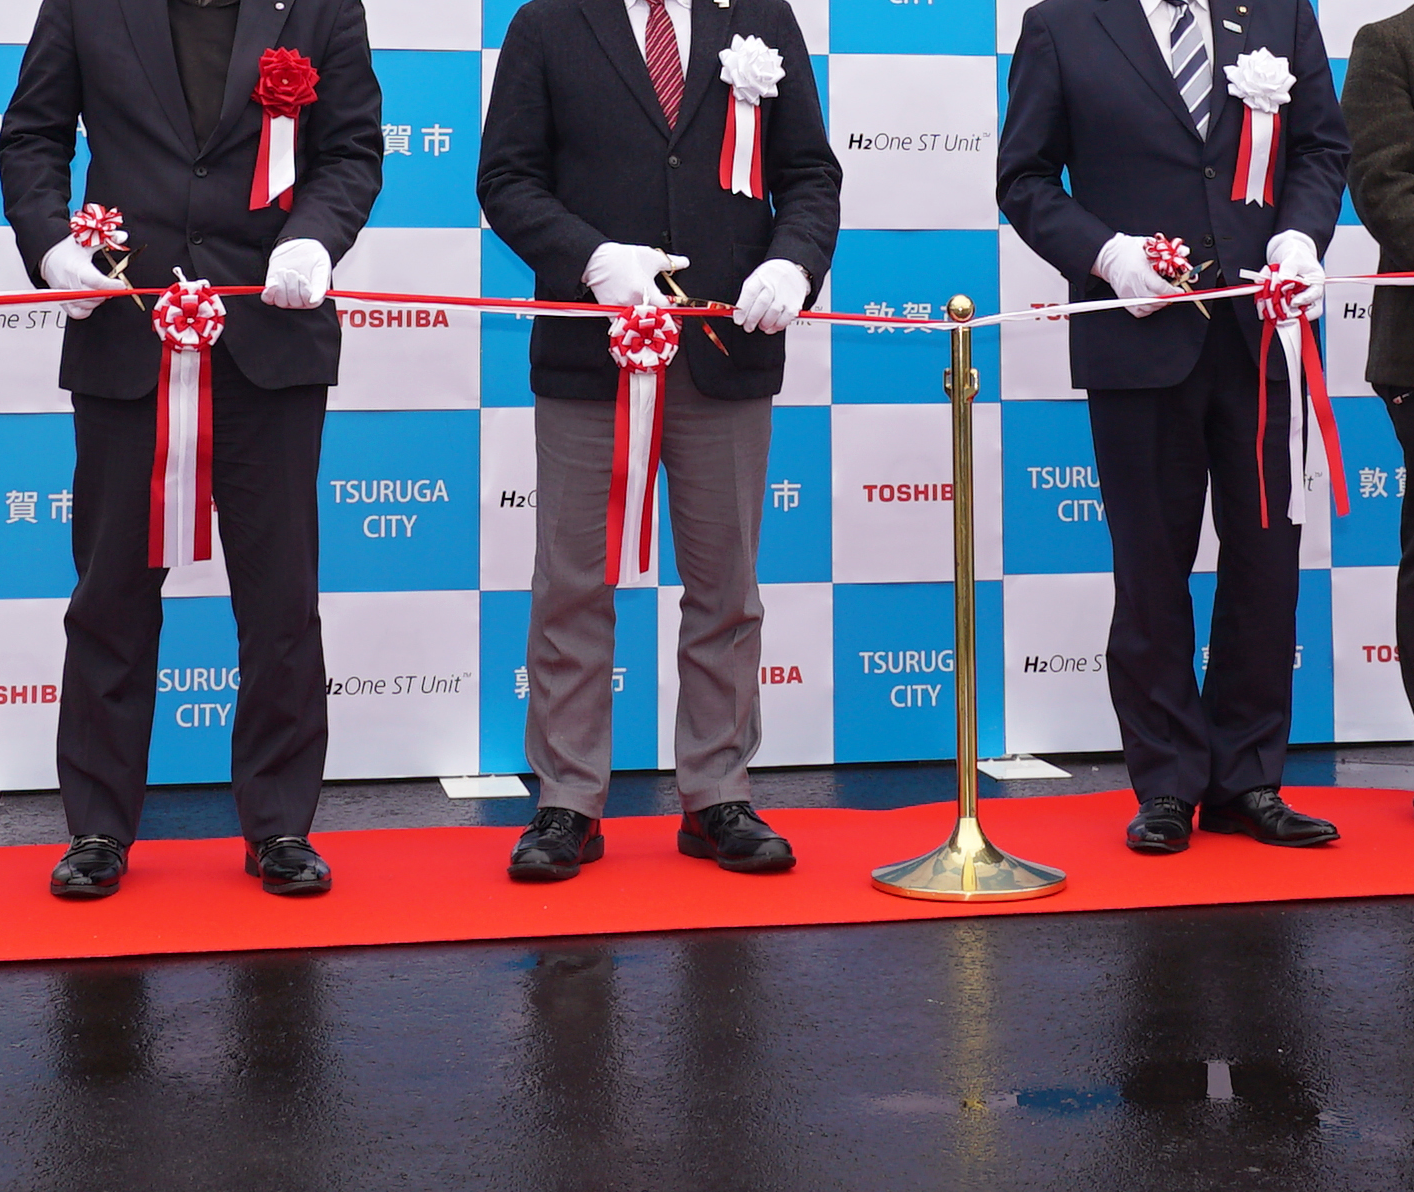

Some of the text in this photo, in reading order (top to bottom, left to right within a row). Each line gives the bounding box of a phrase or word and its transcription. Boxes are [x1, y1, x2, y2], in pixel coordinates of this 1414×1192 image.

[381, 123, 454, 157] 賀市
[848, 132, 913, 151] H2One
[917, 133, 941, 151] ST
[25, 310, 52, 329] ST
[330, 479, 449, 504] TSURUGA
[863, 483, 954, 502] TOSHIB
[1057, 499, 1105, 522] CITY
[362, 514, 417, 538] CITY
[858, 649, 954, 674] TSURUG
[1024, 654, 1087, 673] H2One
[392, 675, 418, 695] ST
[890, 684, 941, 707] CITY
[175, 703, 232, 727] CITY
